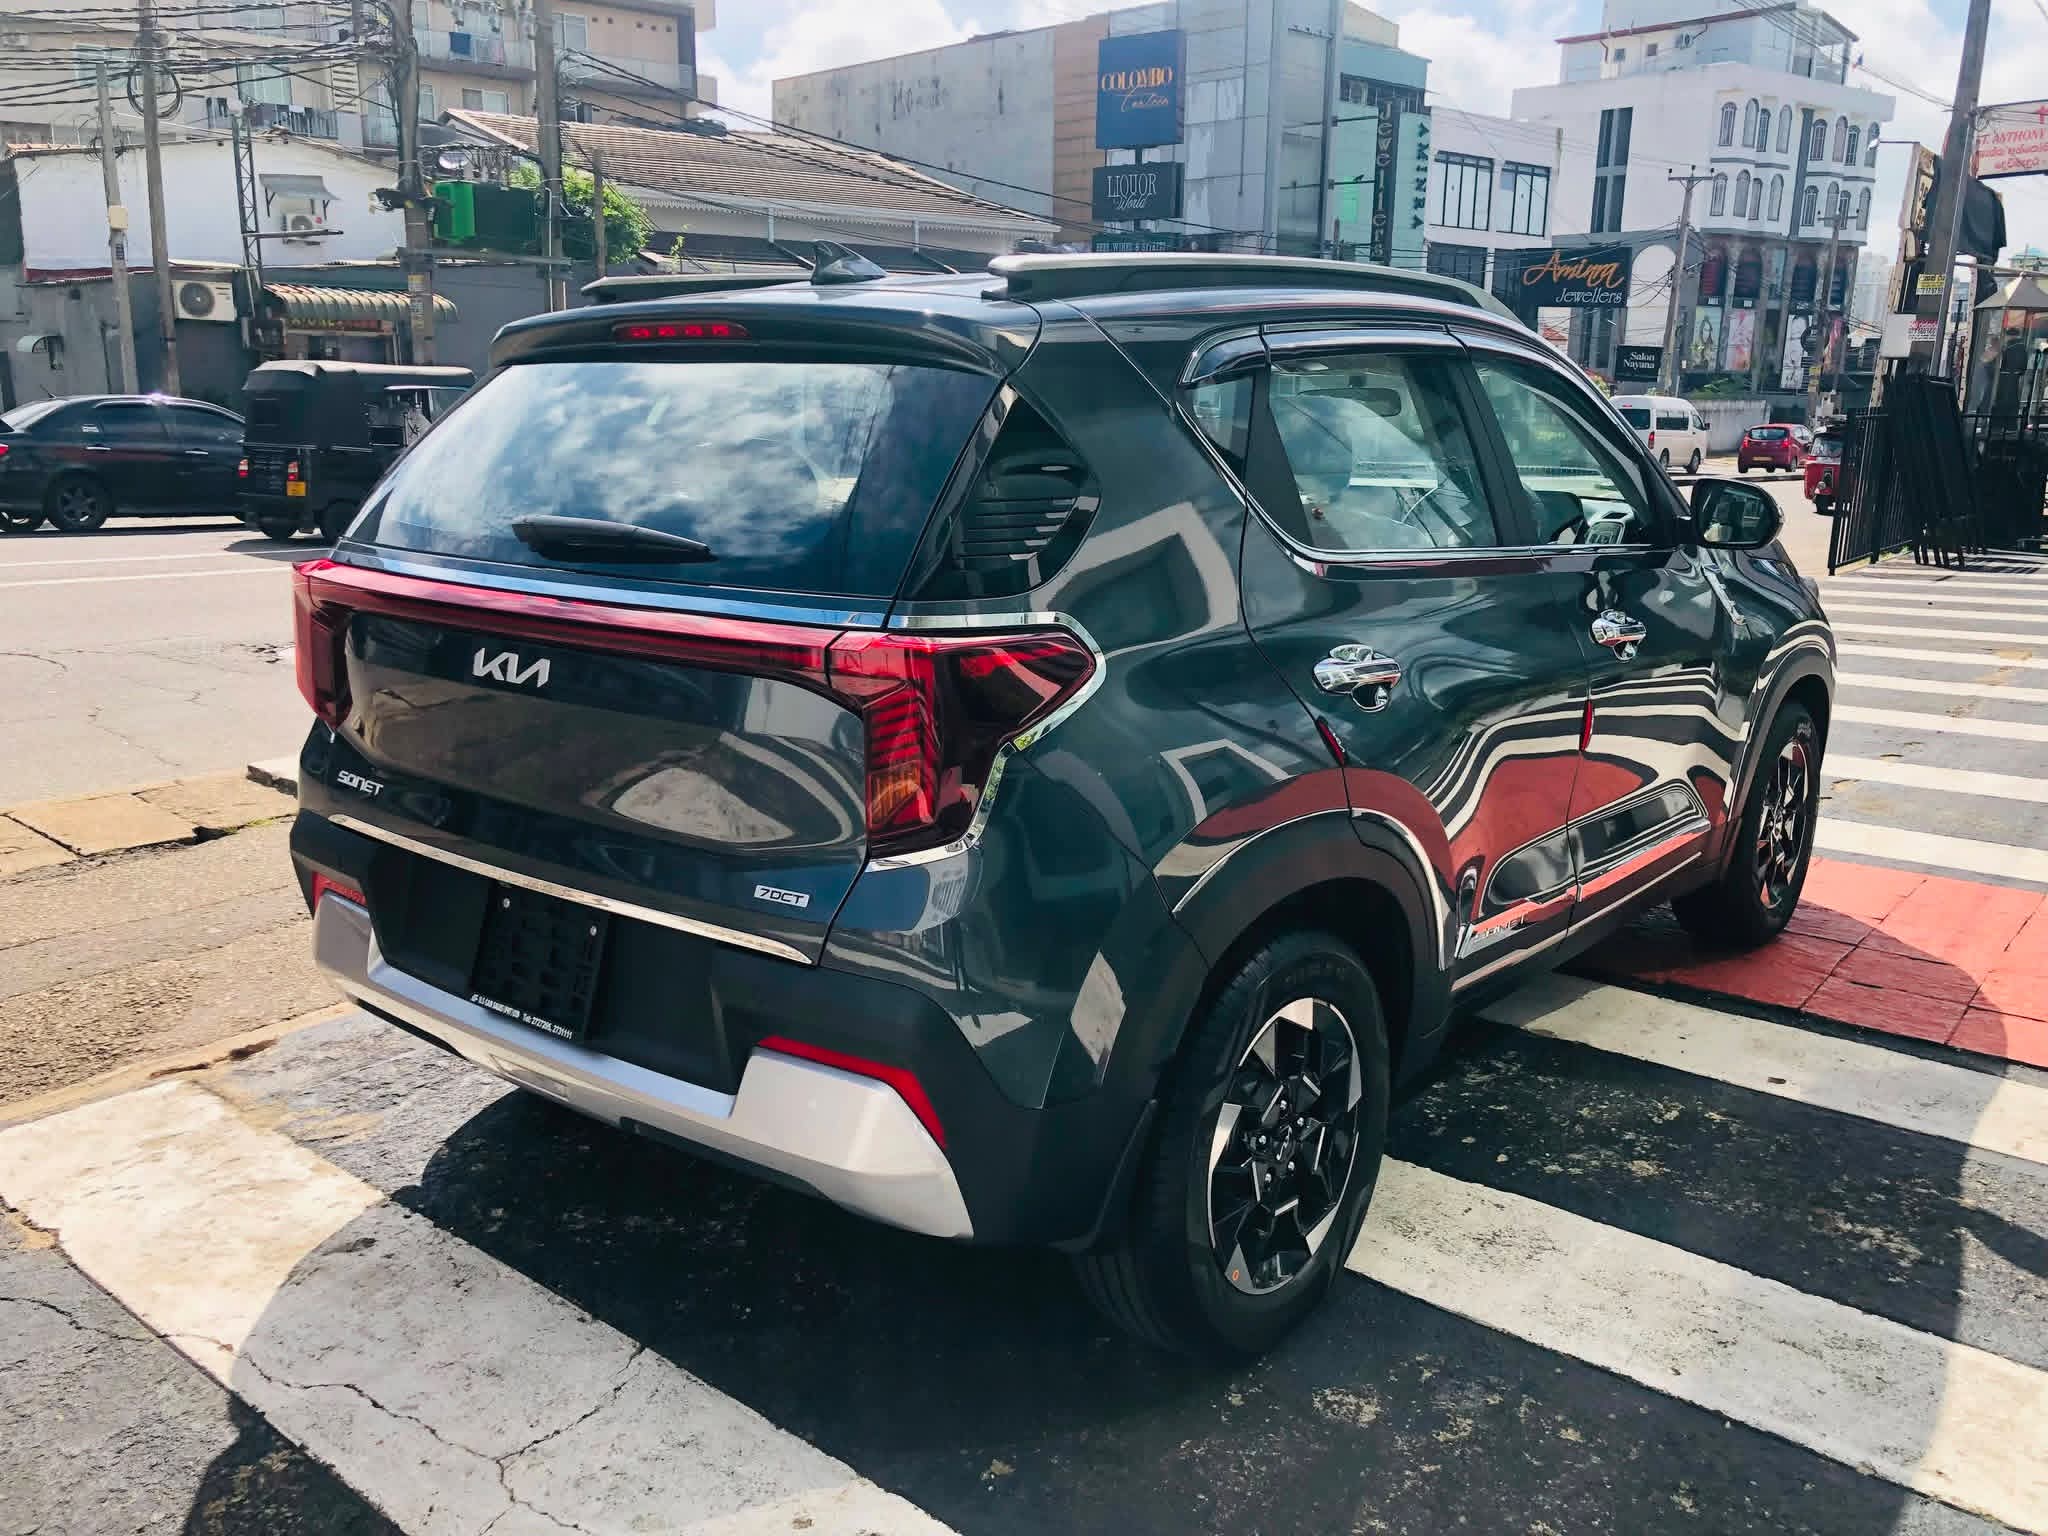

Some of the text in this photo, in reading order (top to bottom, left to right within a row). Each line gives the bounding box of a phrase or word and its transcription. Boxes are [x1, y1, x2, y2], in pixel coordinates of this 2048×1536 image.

[1101, 66, 1174, 91] COLOMBO
[1107, 173, 1157, 199] LIQUOR
[1114, 193, 1152, 213] World
[1555, 287, 1623, 304] Jewellers
[1623, 359, 1655, 370] Nayana
[1630, 351, 1655, 361] Salon
[472, 647, 551, 688] KIA
[337, 770, 384, 796] SONET
[759, 887, 805, 905] 7DCT
